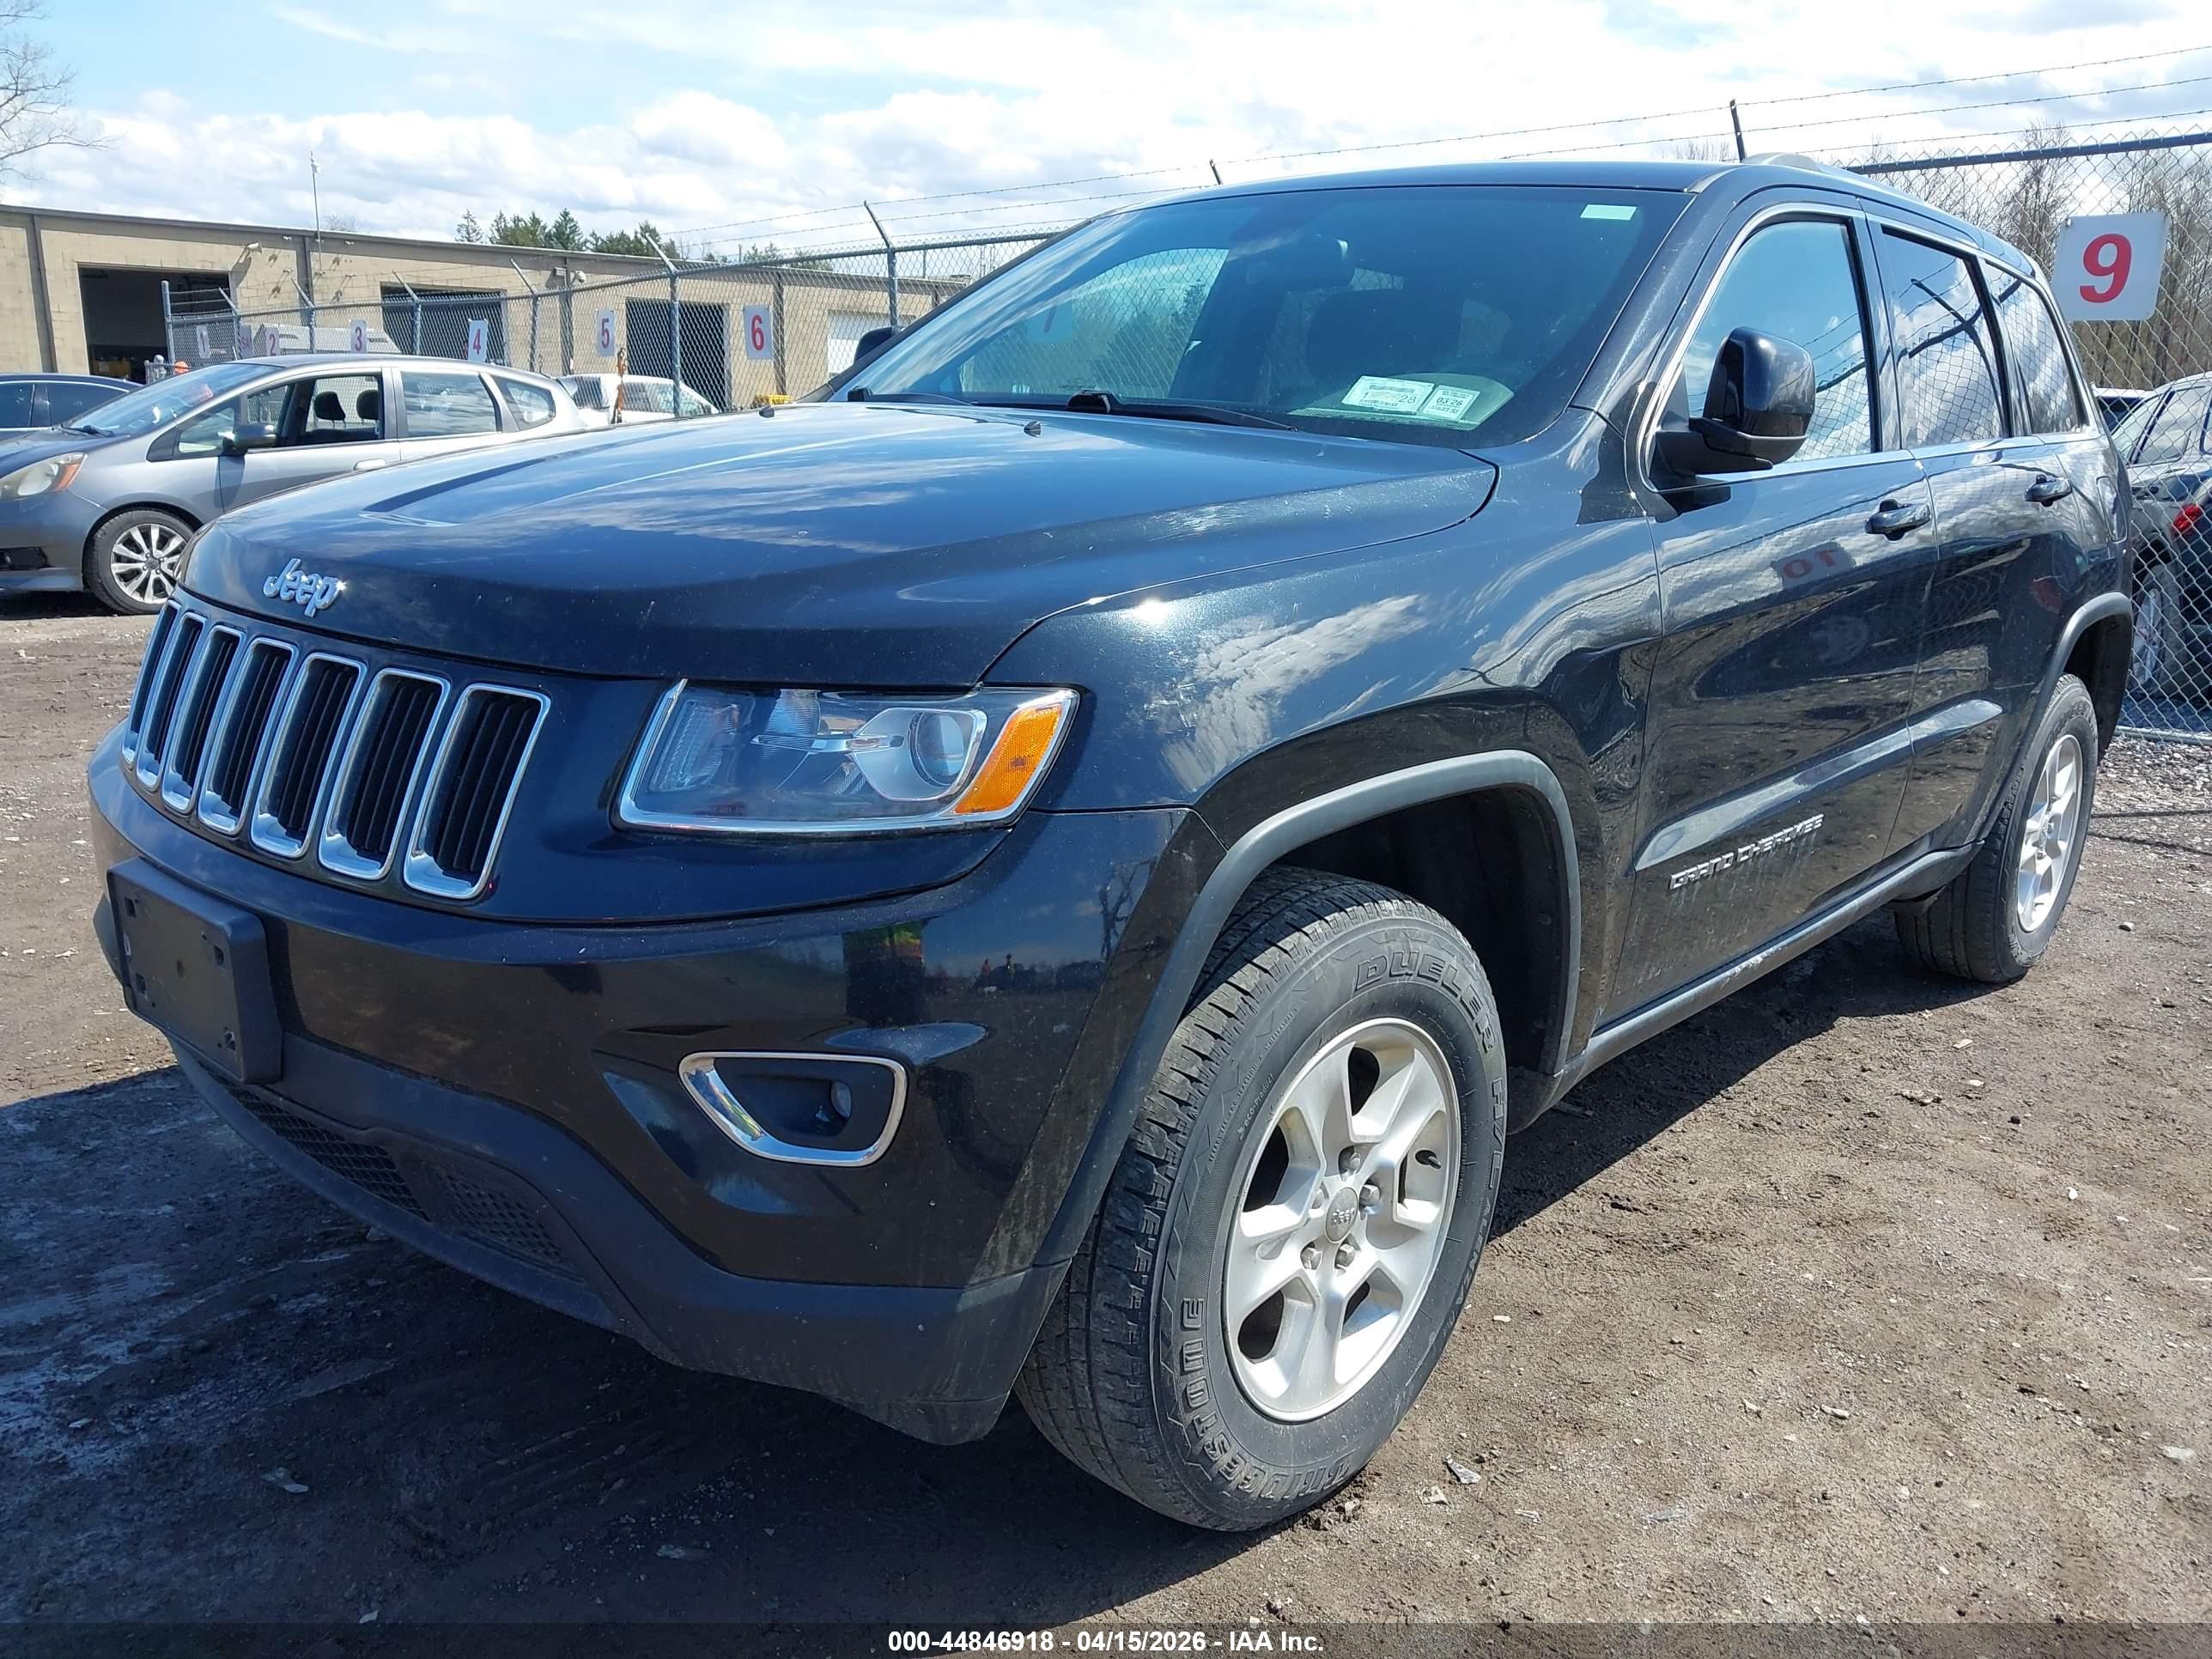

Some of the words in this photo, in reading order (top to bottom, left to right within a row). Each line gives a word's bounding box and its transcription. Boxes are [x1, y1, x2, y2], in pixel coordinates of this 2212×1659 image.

[2079, 233, 2132, 303] 9
[269, 333, 276, 356] 2
[355, 326, 363, 351] 3
[472, 328, 482, 356] 4
[600, 318, 610, 349] 5
[750, 314, 764, 350] 6
[263, 557, 343, 617] Jeep
[1669, 852, 1735, 890] GRAND
[1736, 813, 1825, 862] CHEROKEE
[1354, 950, 1496, 1054] DUELER
